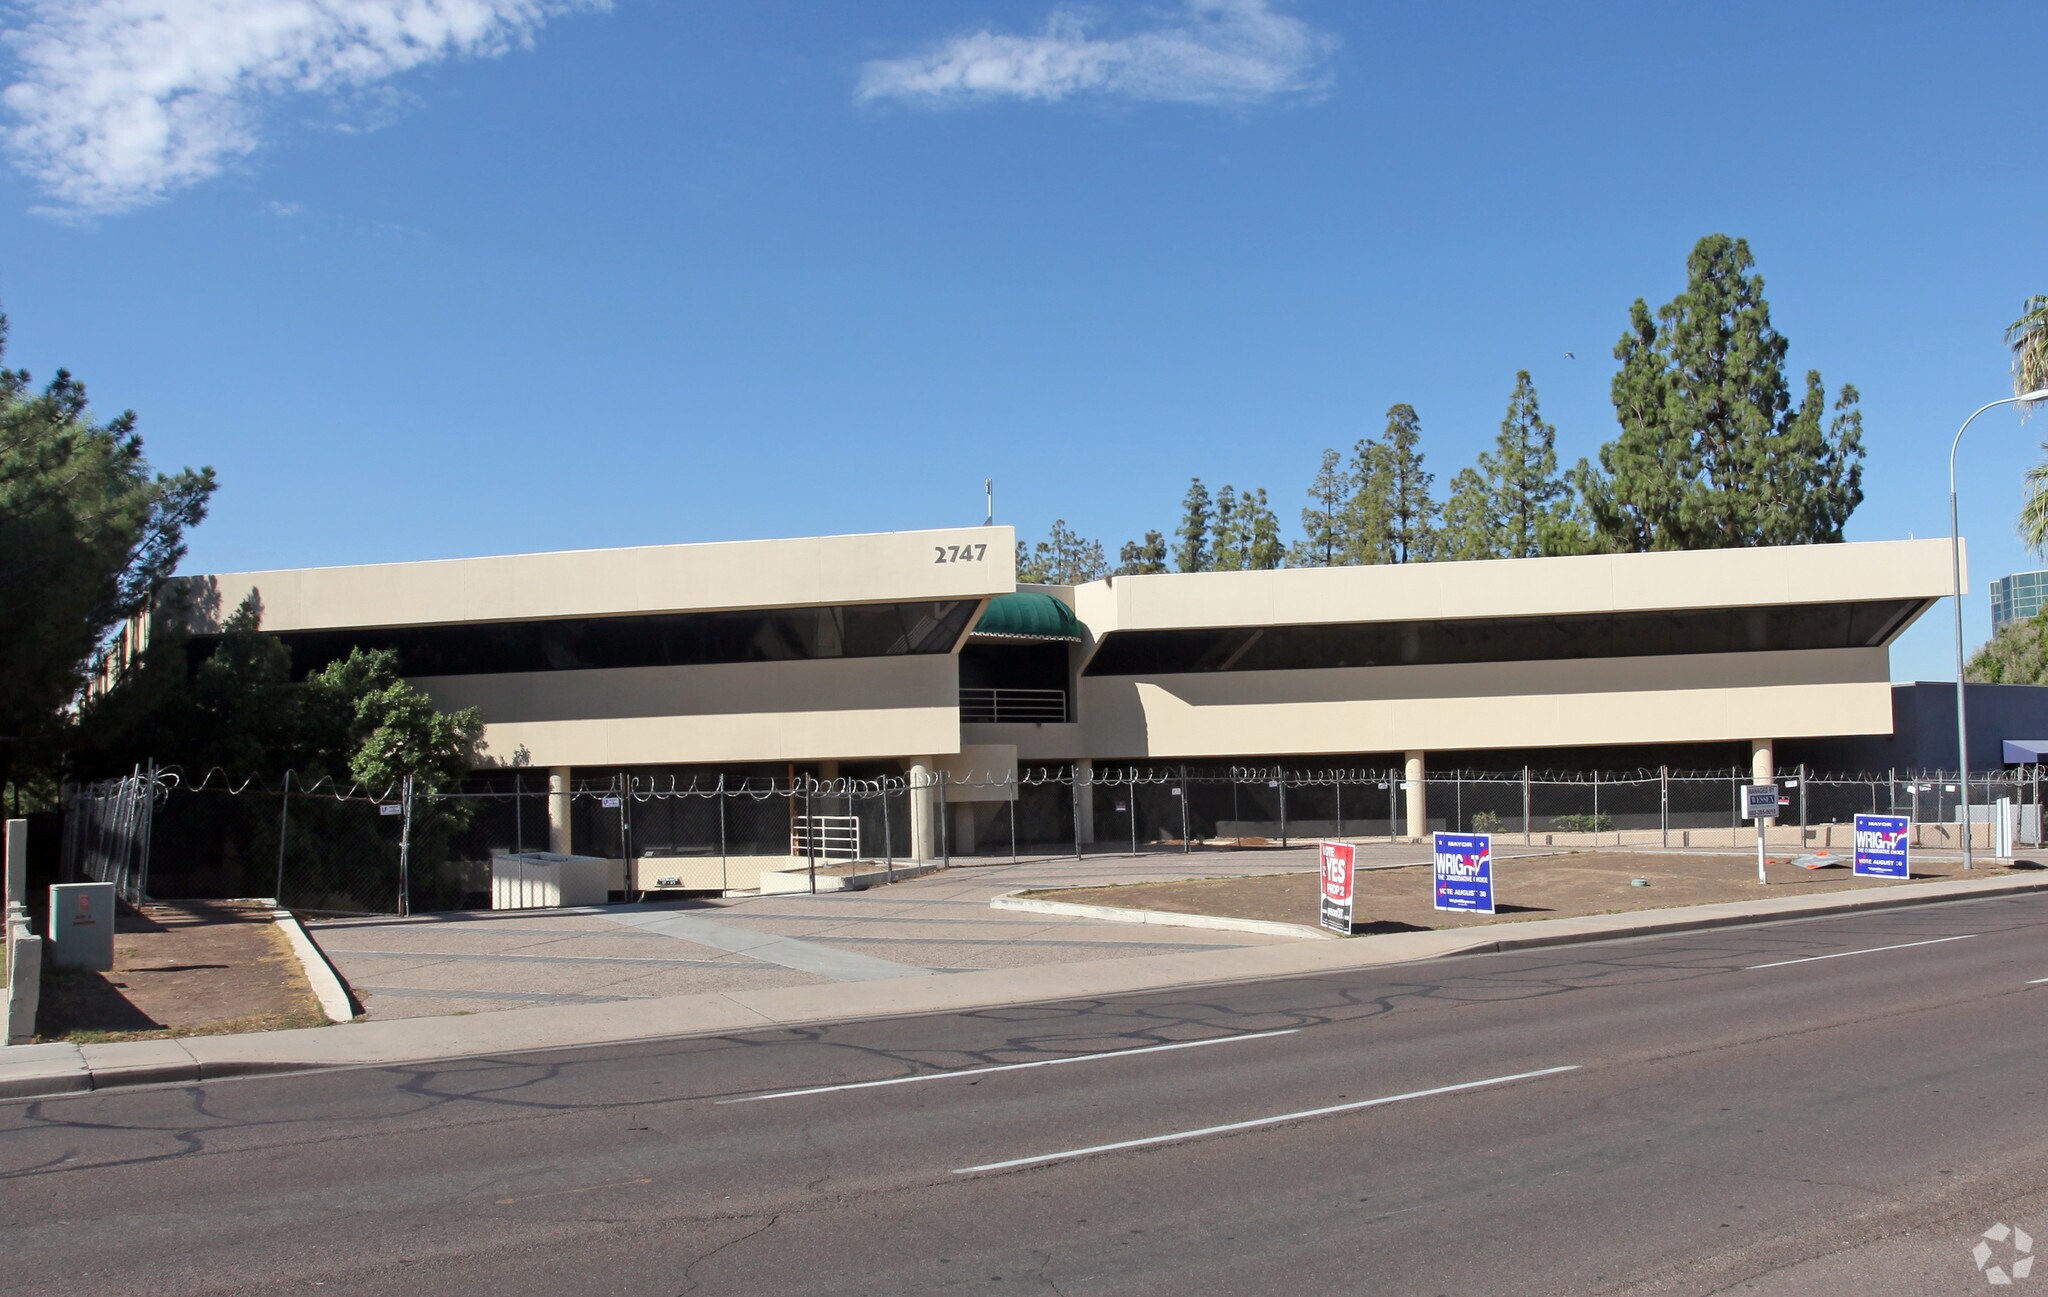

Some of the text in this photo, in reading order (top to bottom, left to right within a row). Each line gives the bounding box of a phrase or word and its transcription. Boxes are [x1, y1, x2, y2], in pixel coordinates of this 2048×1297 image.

[934, 544, 987, 563] 2747
[1856, 830, 1897, 850] WRIGHT
[1326, 857, 1346, 884] YES
[1436, 852, 1480, 876] WRIGHT
[1327, 882, 1345, 897] PROP 2
[1439, 887, 1454, 895] VOTE
[1479, 890, 1487, 898] 30
